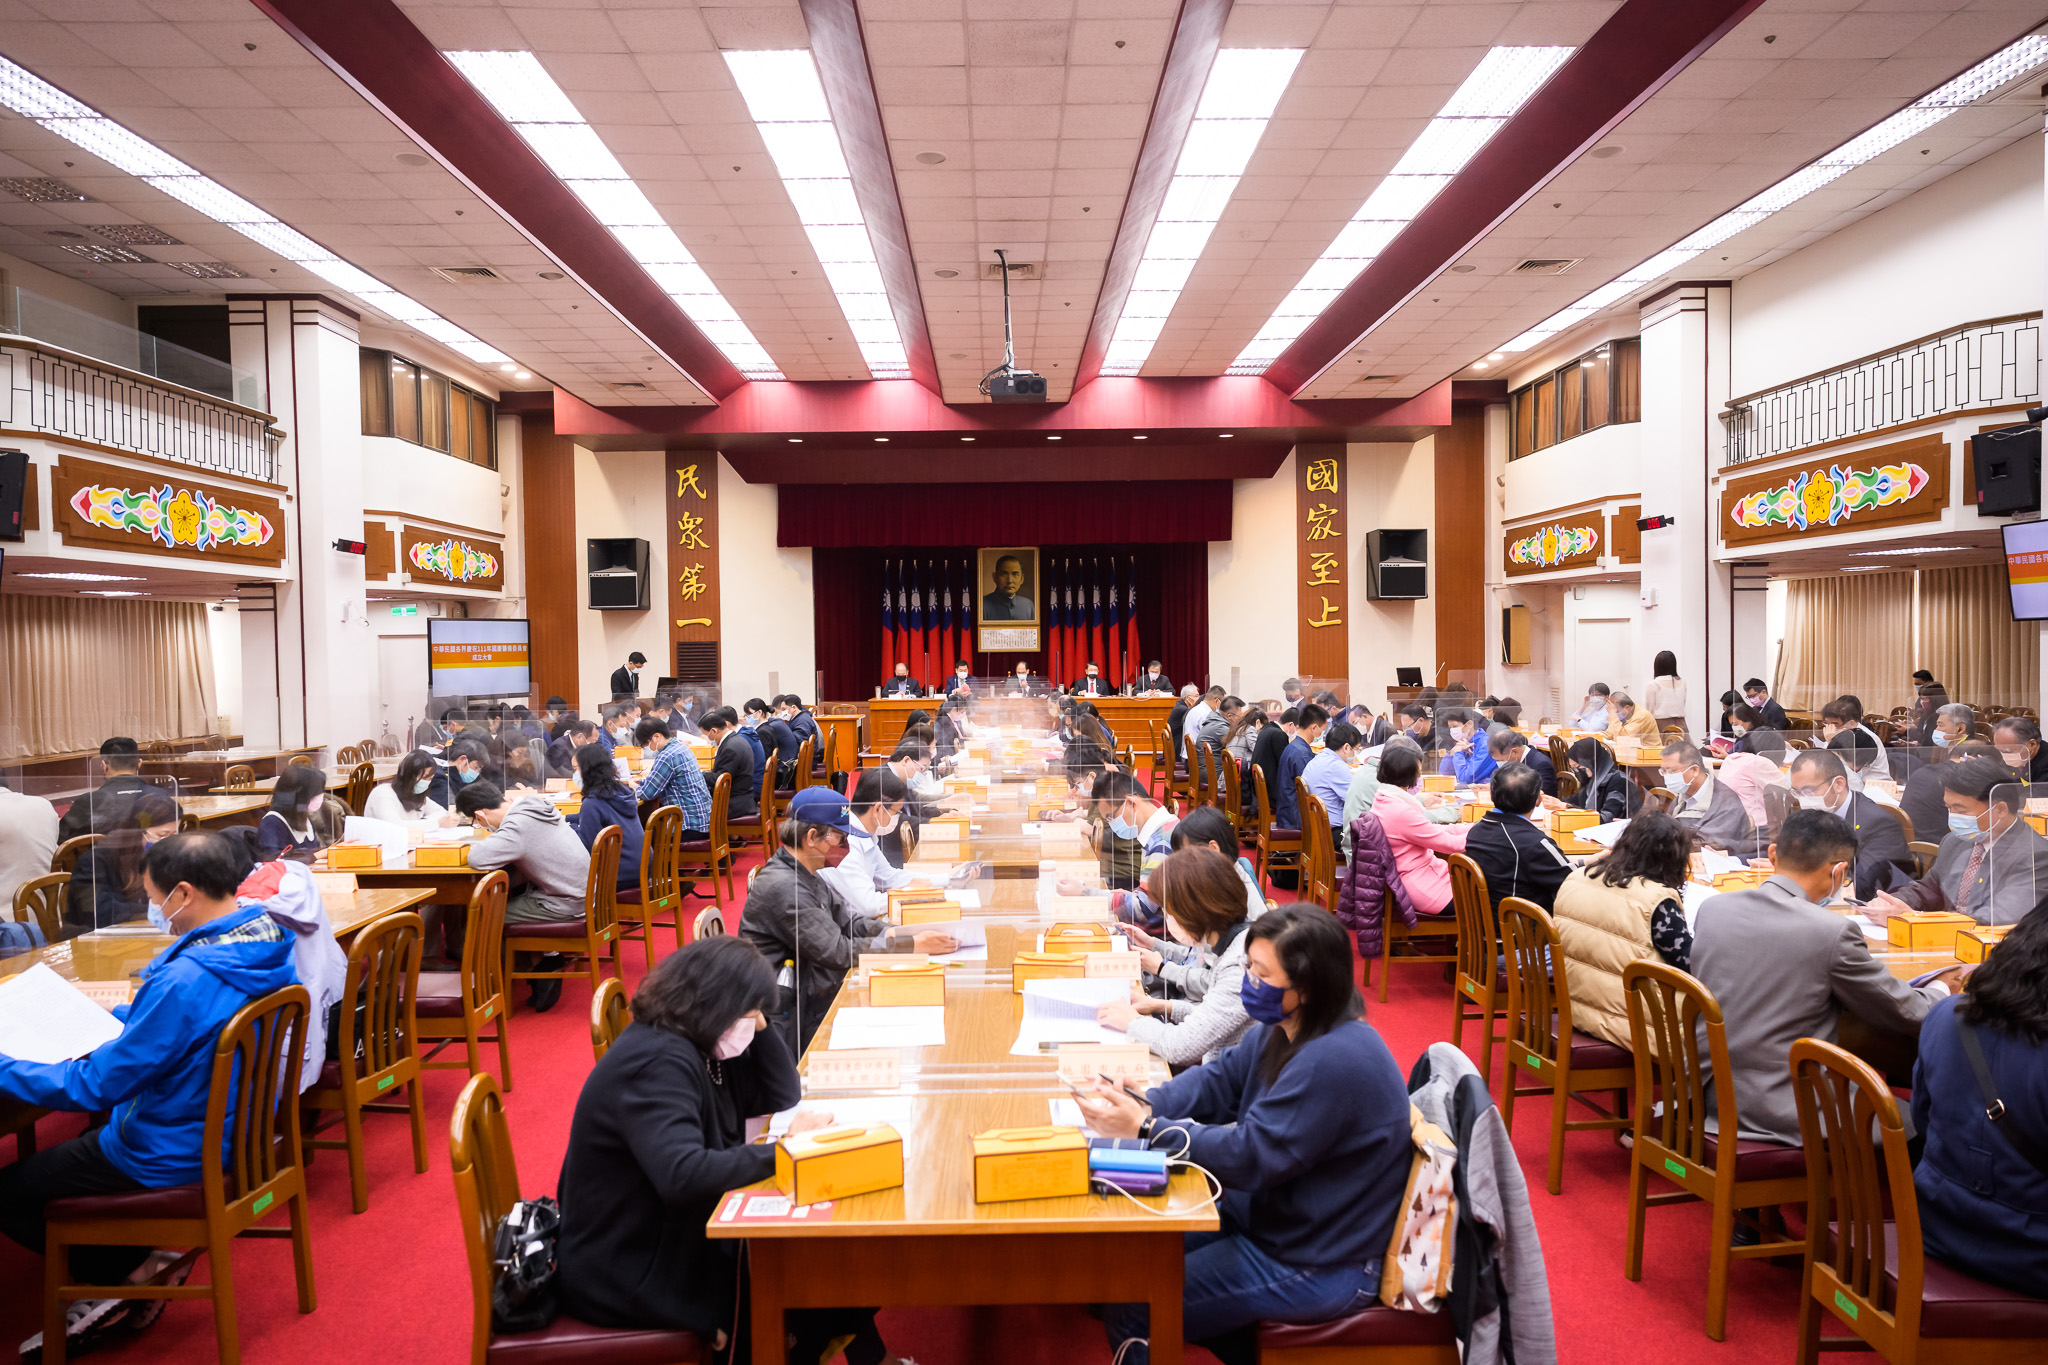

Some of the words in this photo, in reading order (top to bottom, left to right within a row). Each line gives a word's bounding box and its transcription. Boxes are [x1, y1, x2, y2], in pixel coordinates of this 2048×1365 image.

[1306, 458, 1342, 628] 國家至上
[2008, 553, 2048, 565] 中華民國各界
[1063, 1064, 1144, 1075] 桃園市政府
